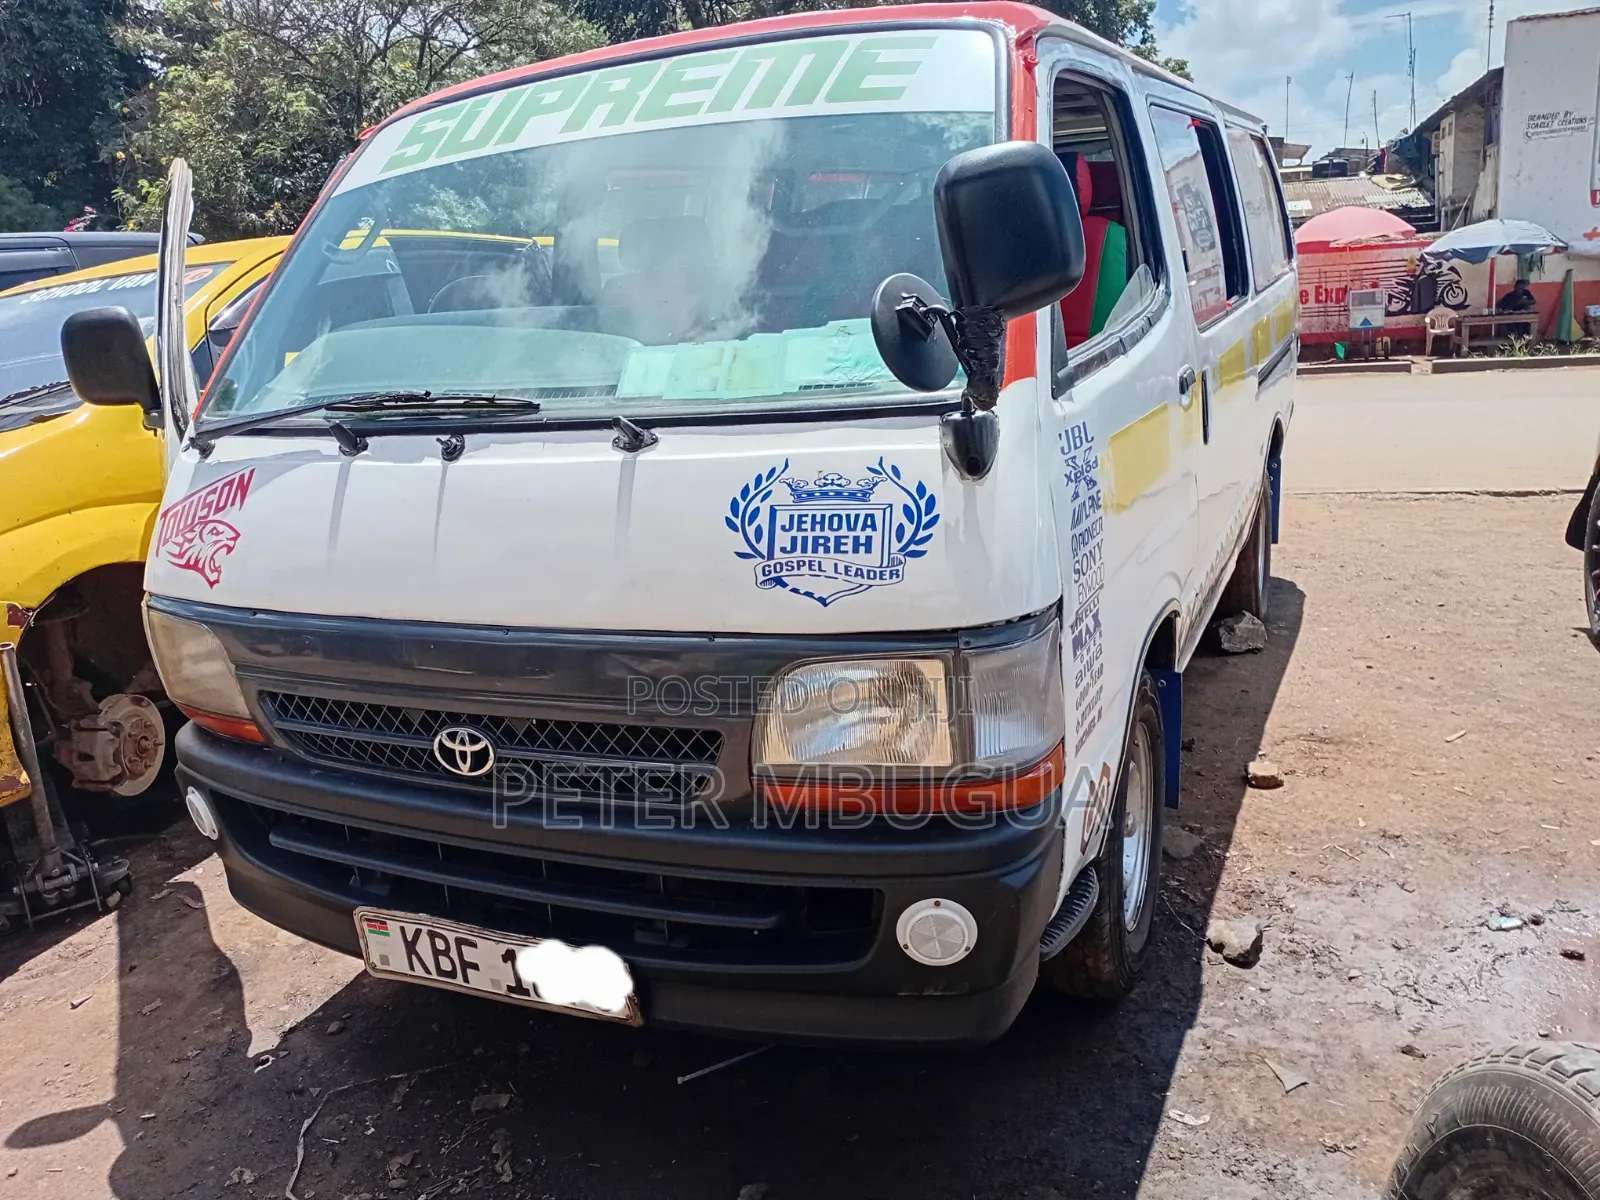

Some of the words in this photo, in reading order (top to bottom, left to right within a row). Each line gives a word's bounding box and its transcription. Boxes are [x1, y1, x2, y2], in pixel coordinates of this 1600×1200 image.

[380, 35, 940, 175] SUPREME
[20, 279, 111, 305] SCHOOL
[107, 272, 158, 291] VAN
[1058, 421, 1095, 456] JBL
[780, 513, 878, 533] JEHOVA
[779, 535, 873, 555] JIREH
[1073, 538, 1104, 584] SONY
[761, 559, 827, 578] GOSPEL
[833, 562, 901, 581] LEADER
[1072, 606, 1102, 662] MAX
[1075, 643, 1103, 690] aiwa
[399, 925, 480, 984] KBF
